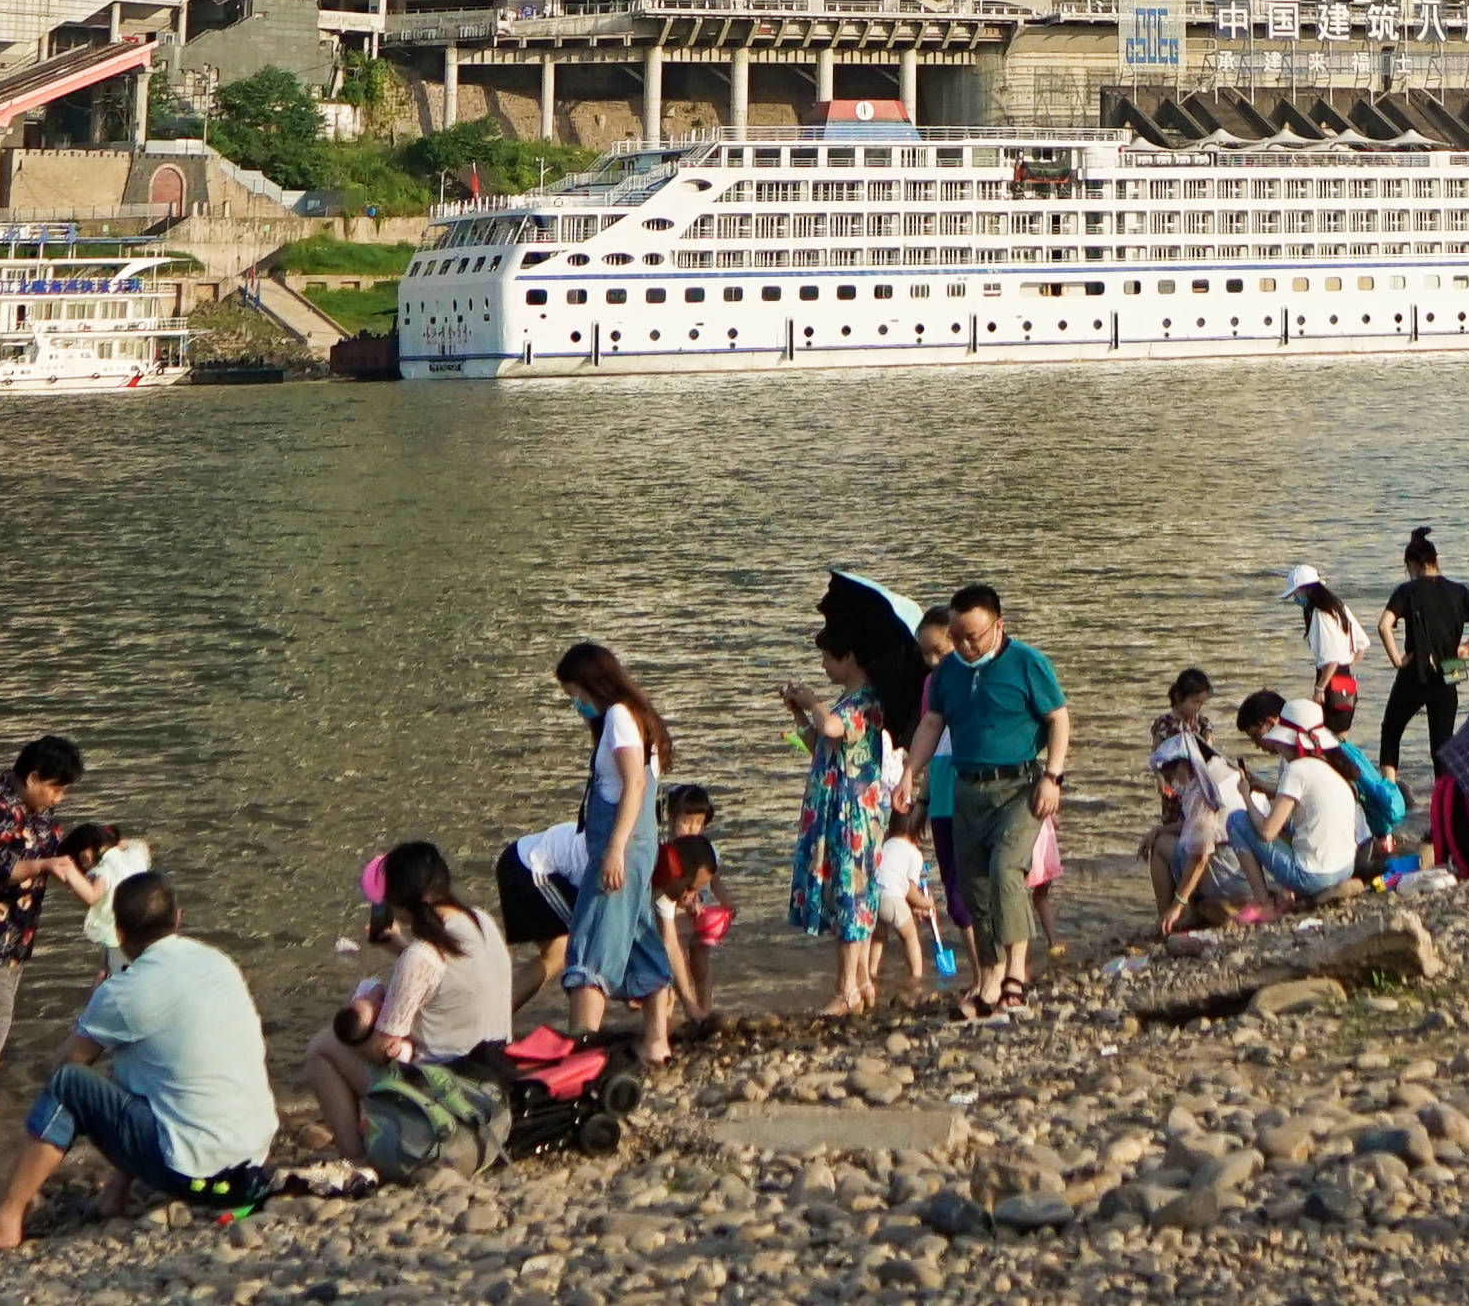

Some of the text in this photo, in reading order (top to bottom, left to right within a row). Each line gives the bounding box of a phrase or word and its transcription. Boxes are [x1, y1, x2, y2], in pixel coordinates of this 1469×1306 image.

[1217, 50, 1413, 74] 承建来福士
